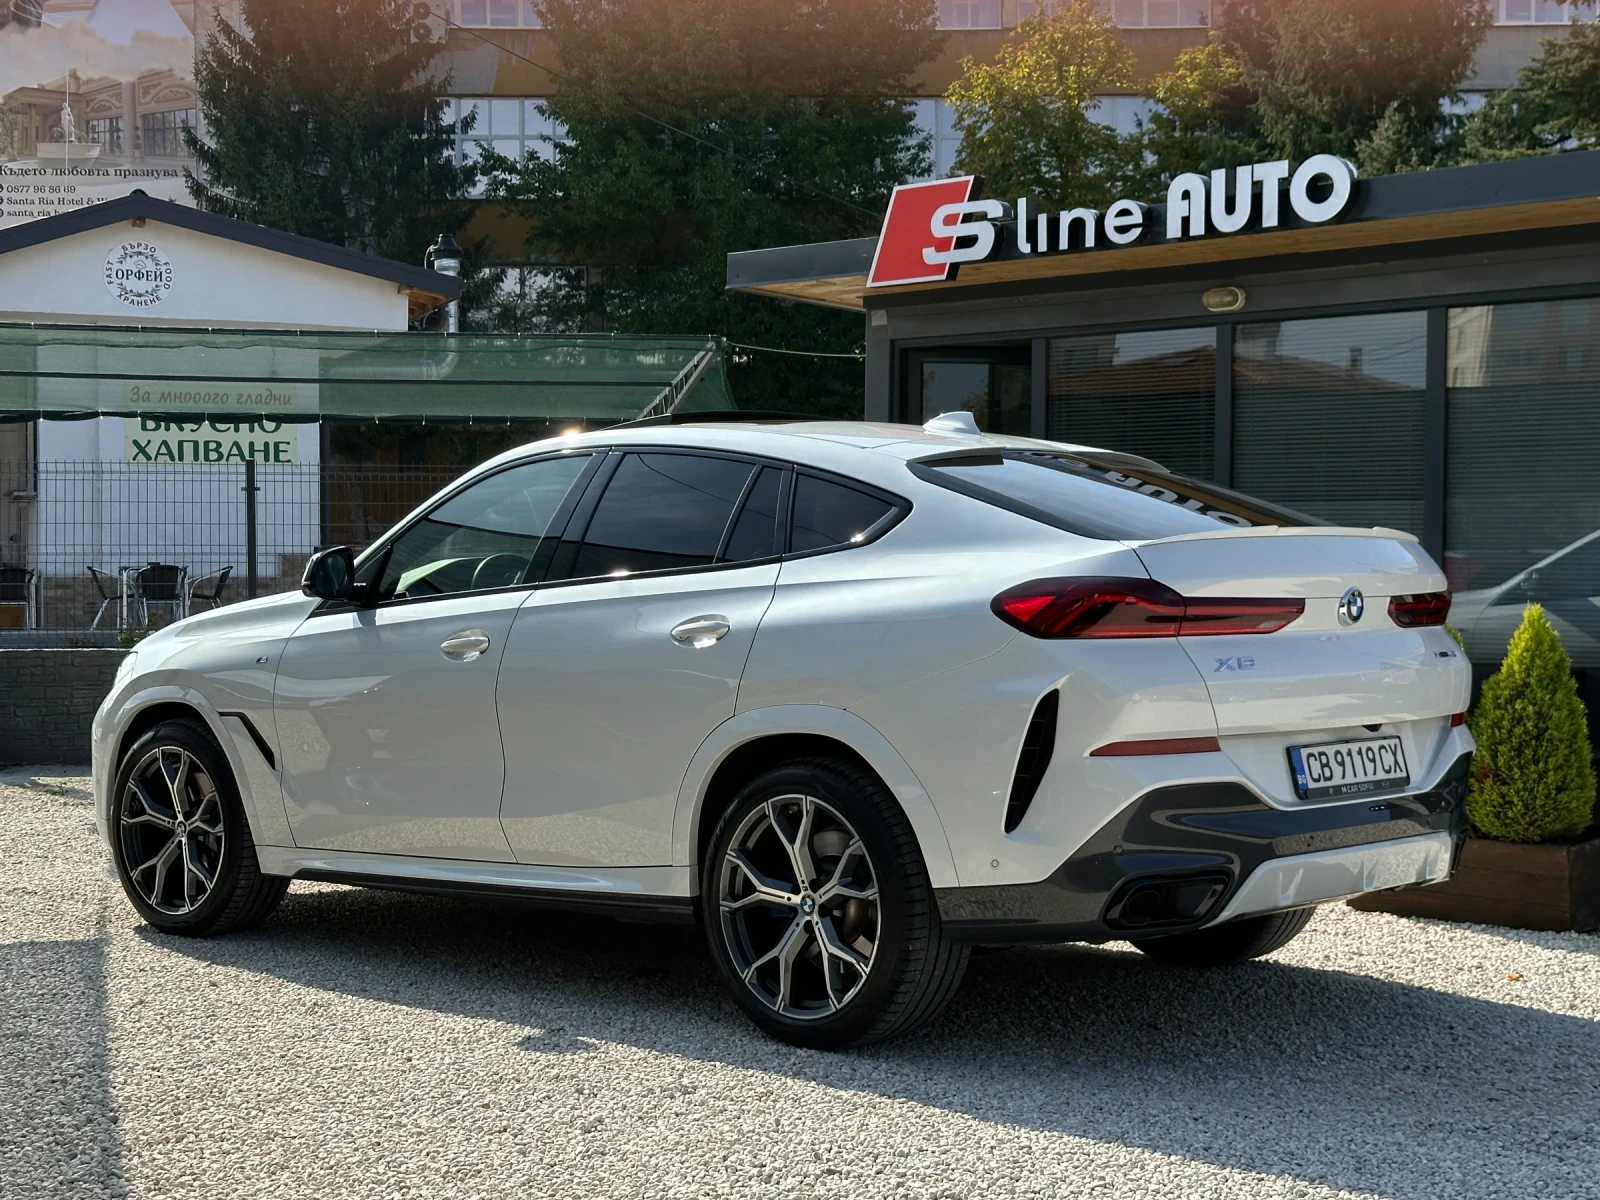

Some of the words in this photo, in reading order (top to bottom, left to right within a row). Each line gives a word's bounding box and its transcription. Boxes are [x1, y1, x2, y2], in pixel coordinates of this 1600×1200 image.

[0, 165, 47, 178] Където
[50, 166, 110, 177] любовта
[113, 167, 178, 179] празнува
[6, 185, 31, 194] 0877
[33, 185, 46, 194] 96
[48, 185, 61, 194] 86
[63, 185, 76, 194] 69
[6, 197, 35, 206] Santa
[38, 197, 54, 206] Ria
[57, 197, 83, 206] Hotel
[1017, 197, 1147, 254] line
[1166, 153, 1352, 240] AUTO
[121, 242, 157, 254] БЪРЗО
[105, 260, 115, 285] FAST
[115, 267, 163, 283] ОРФЕЙ
[163, 261, 173, 290] FOOD
[116, 292, 162, 307] ХРАНЕНЕ
[130, 386, 151, 404] За
[236, 388, 292, 407] гладни
[132, 439, 292, 463] ХАПВАНЕ
[1214, 655, 1256, 673] X6
[1297, 774, 1307, 785] BG
[1347, 785, 1359, 793] CAR
[1359, 783, 1375, 792] SOFIA
